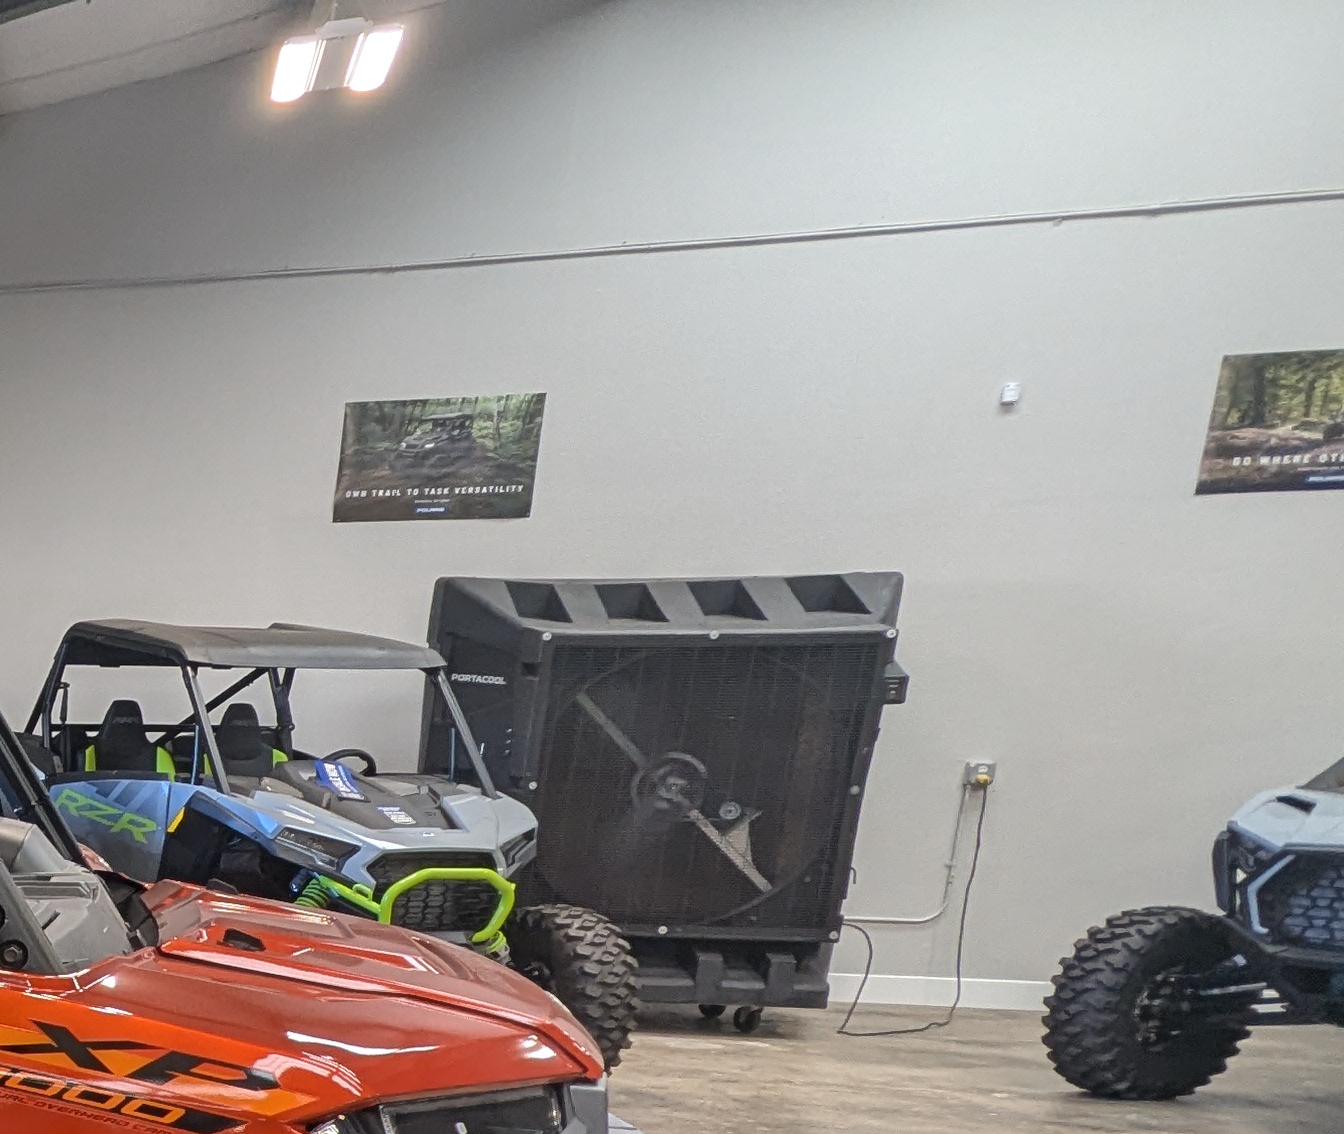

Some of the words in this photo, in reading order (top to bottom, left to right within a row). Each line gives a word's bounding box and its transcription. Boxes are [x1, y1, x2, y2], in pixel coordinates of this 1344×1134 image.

[1232, 456, 1252, 466] GO
[371, 489, 401, 498] TRAIL
[407, 488, 419, 496] TO
[454, 484, 524, 495] VERSATILITY
[451, 673, 507, 685] PORTACOOL
[56, 788, 157, 844] RZR
[33, 1101, 130, 1128] OVERHEAD
